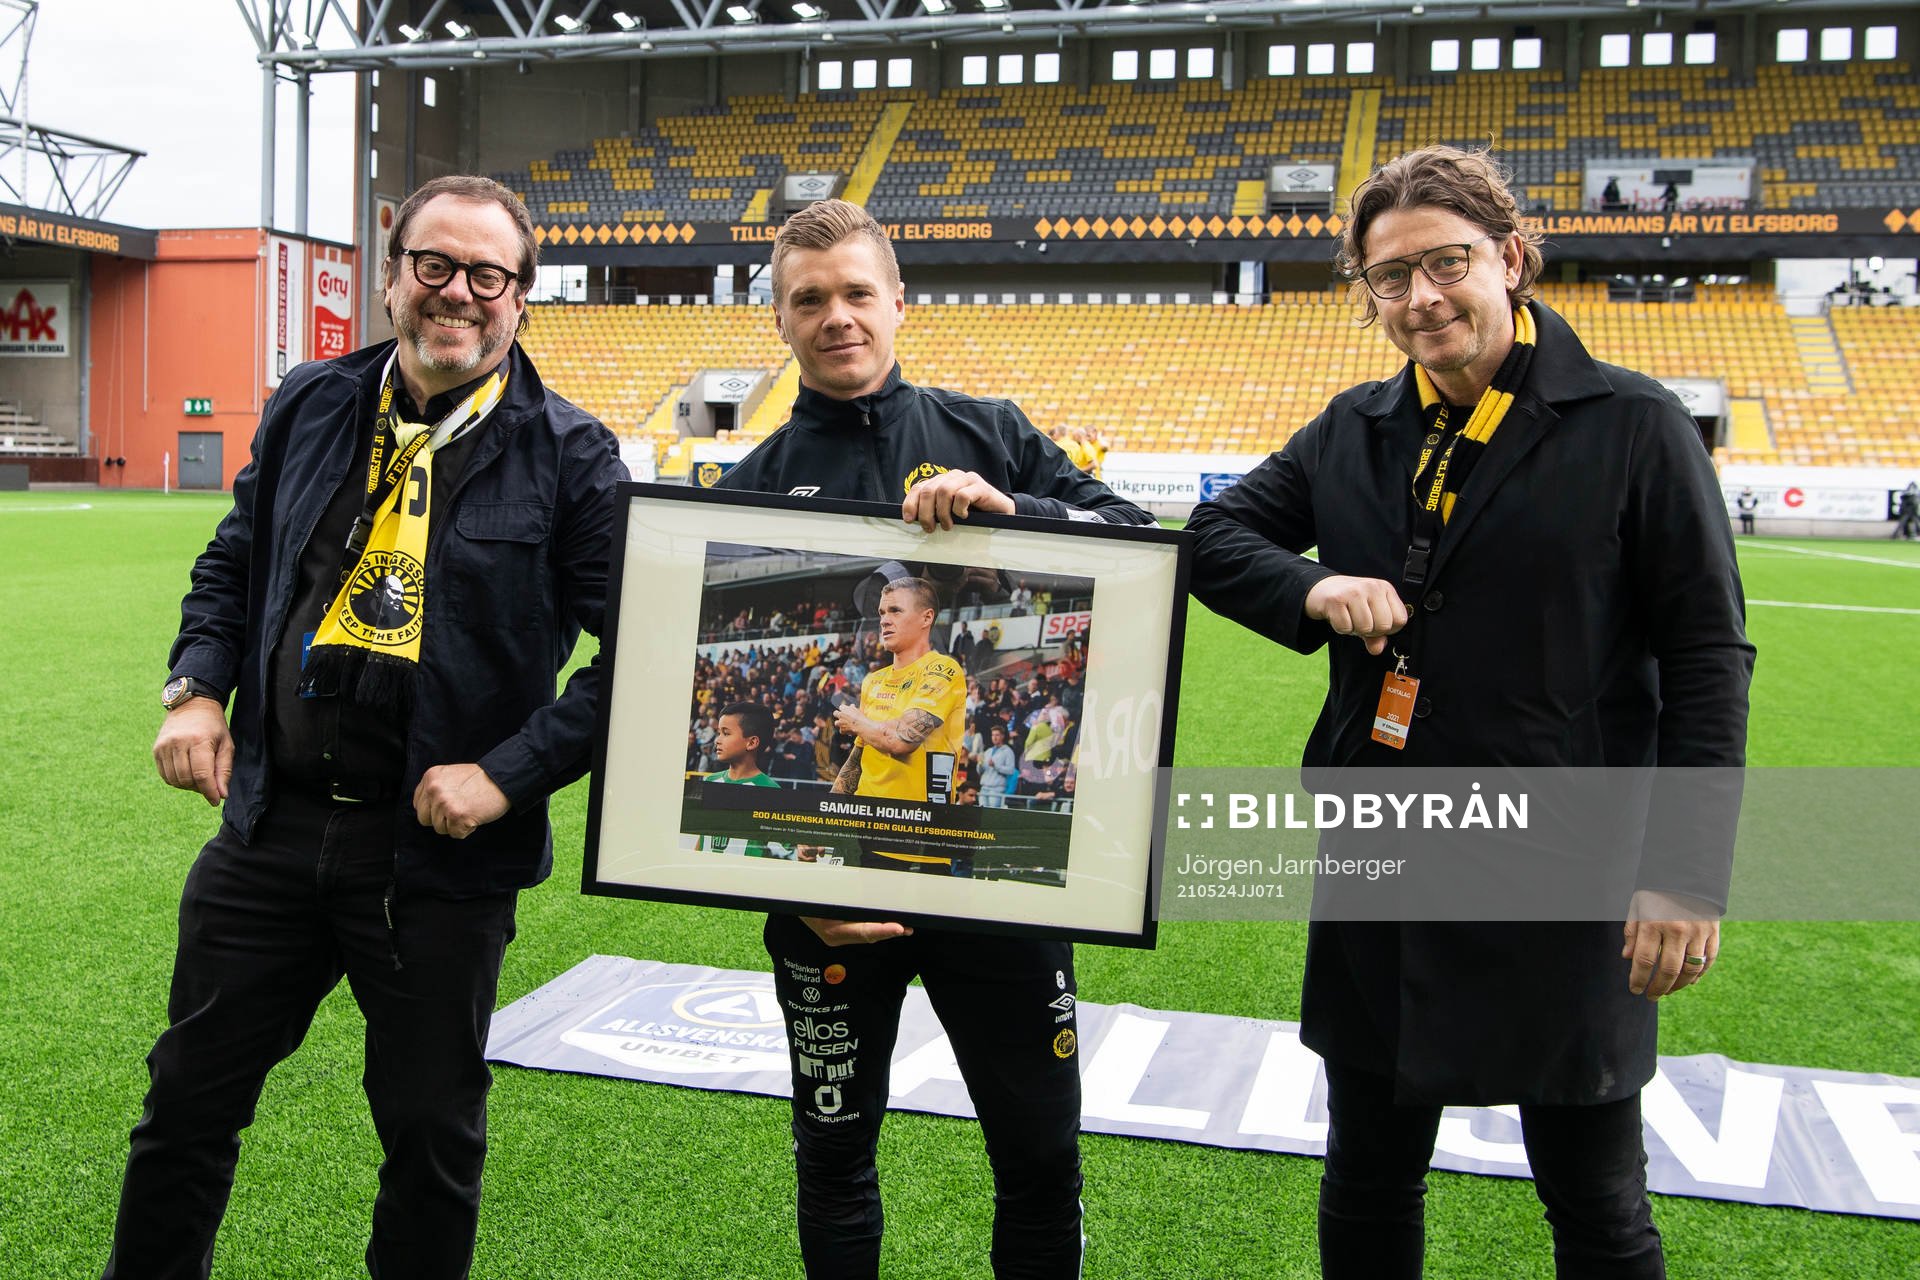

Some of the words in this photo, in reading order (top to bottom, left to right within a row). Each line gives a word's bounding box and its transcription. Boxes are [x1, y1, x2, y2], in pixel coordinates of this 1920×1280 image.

[904, 223, 992, 240] ELFSBORG
[1702, 215, 1725, 233] VI
[1729, 214, 1838, 233] ELFSBORG
[40, 222, 54, 241] VI
[57, 225, 119, 252] ELFSBORG
[320, 330, 345, 350] 7-23
[374, 435, 385, 446] IF
[385, 474, 397, 486] IF
[394, 432, 430, 475] ELFSBORG
[1425, 459, 1448, 512] ELFSBORG
[340, 601, 359, 629] EEP
[820, 801, 873, 817] SAMUEL
[876, 807, 931, 822] HOLMÉN
[752, 811, 770, 820] 200
[771, 813, 824, 825] ALLSVENSKA
[825, 818, 866, 829] MATCHER
[866, 821, 872, 829] I
[873, 822, 890, 831] DEN
[892, 824, 913, 833] GULA
[915, 827, 996, 841] ELFSBORGSTRÖJAN.
[784, 958, 820, 974] Sparbanken
[1056, 970, 1066, 990] 8
[788, 1000, 831, 1013] TOVEKS
[833, 1003, 850, 1012] BIL
[600, 1018, 788, 1050] ALLSVENSKA
[794, 1016, 849, 1041] ellos
[620, 1042, 752, 1064] UNIBET
[794, 1037, 859, 1056] PULSEN
